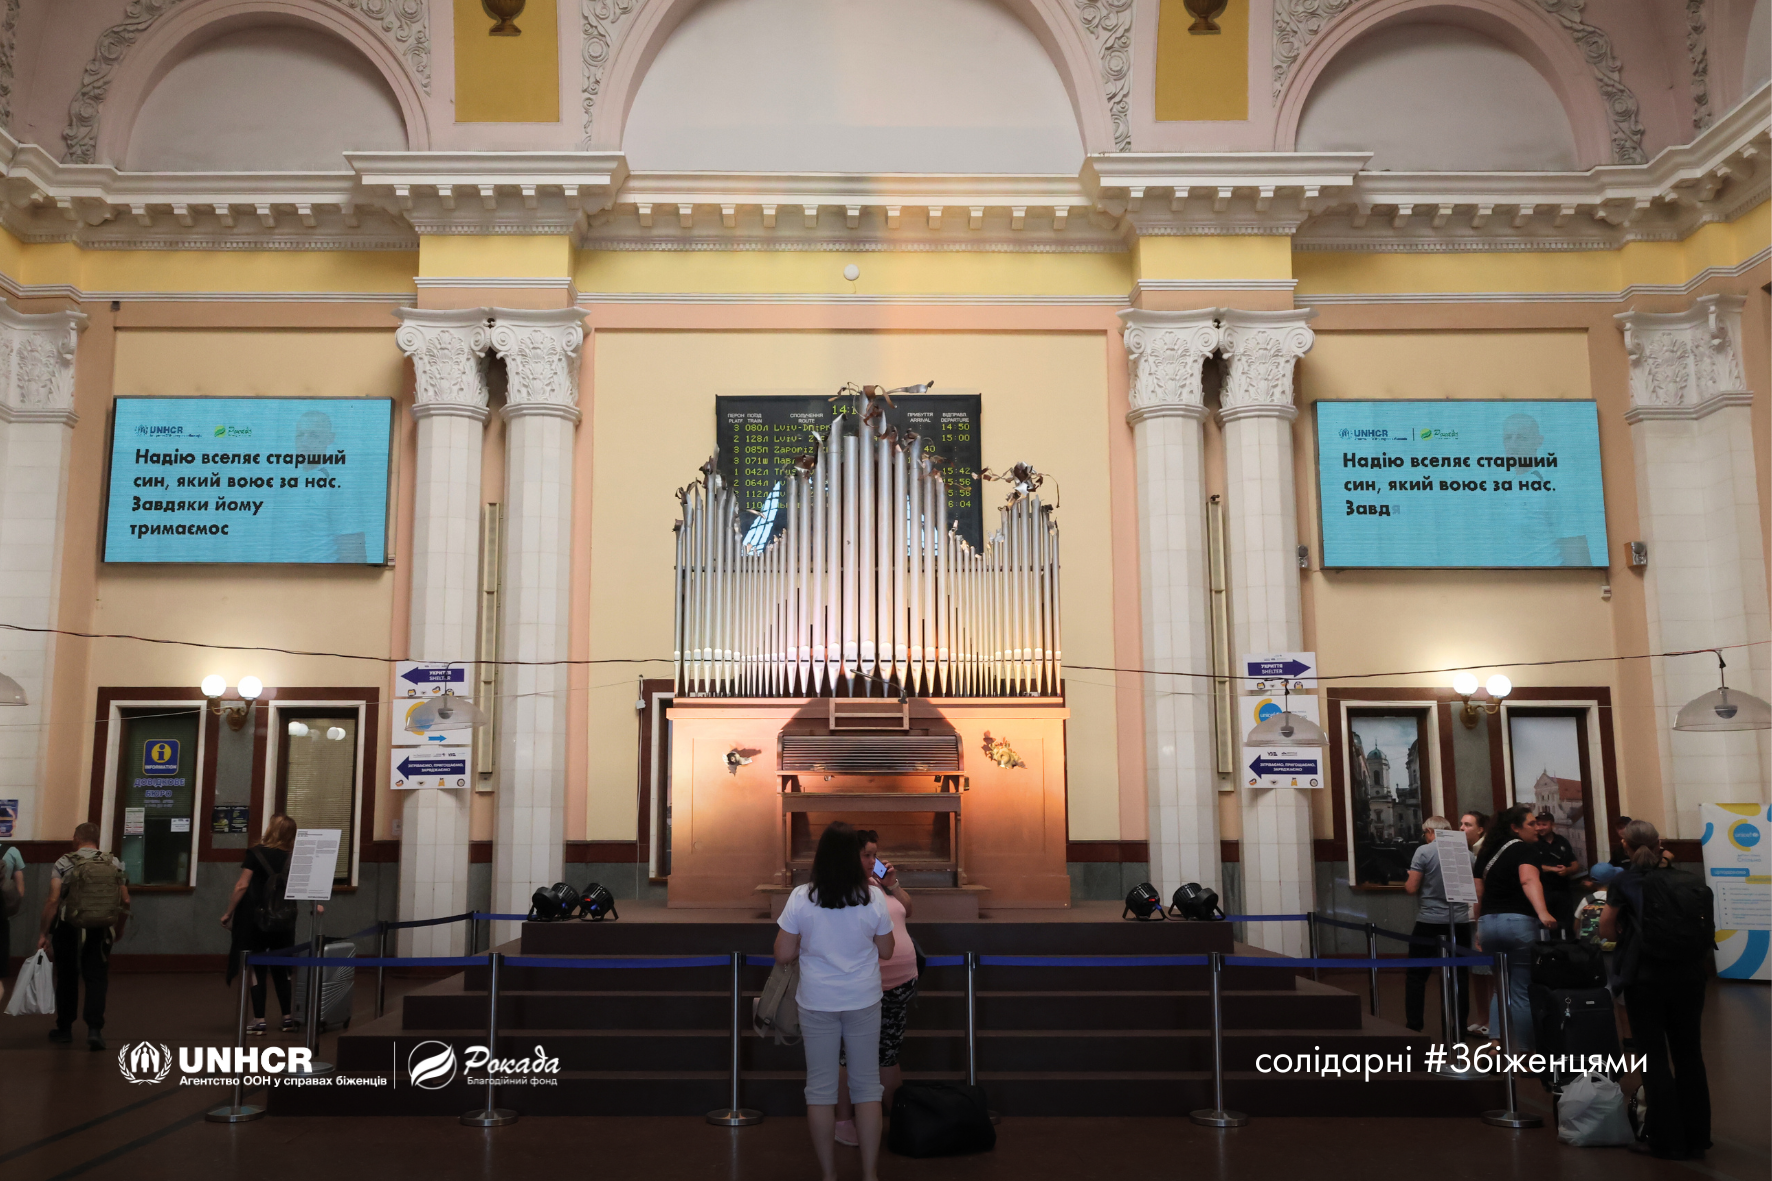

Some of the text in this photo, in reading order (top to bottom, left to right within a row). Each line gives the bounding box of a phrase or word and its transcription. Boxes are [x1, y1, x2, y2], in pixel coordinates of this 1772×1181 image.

[832, 404, 857, 415] 14:1
[150, 426, 184, 434] UNHCR
[941, 423, 970, 431] 14:50
[1353, 429, 1389, 438] UNHCR
[733, 435, 740, 443] 2
[941, 434, 970, 442] 15:00
[733, 446, 740, 454] 3
[135, 448, 346, 469] Надію вселяє старший
[733, 457, 740, 465] 3
[1343, 451, 1558, 472] Надію вселяє старший
[734, 468, 740, 476] 1
[942, 467, 971, 475] 15:42
[133, 471, 341, 491] син, який воює за нас.
[733, 479, 740, 487] 2
[1344, 475, 1556, 494] син, який воює за нас.
[131, 495, 264, 516] Завдяки йому
[746, 500, 972, 509] 110 6:04
[129, 523, 229, 540] тримаємос
[133, 778, 186, 788] ДОВІДКОВЕ
[144, 789, 173, 798] БЮРО
